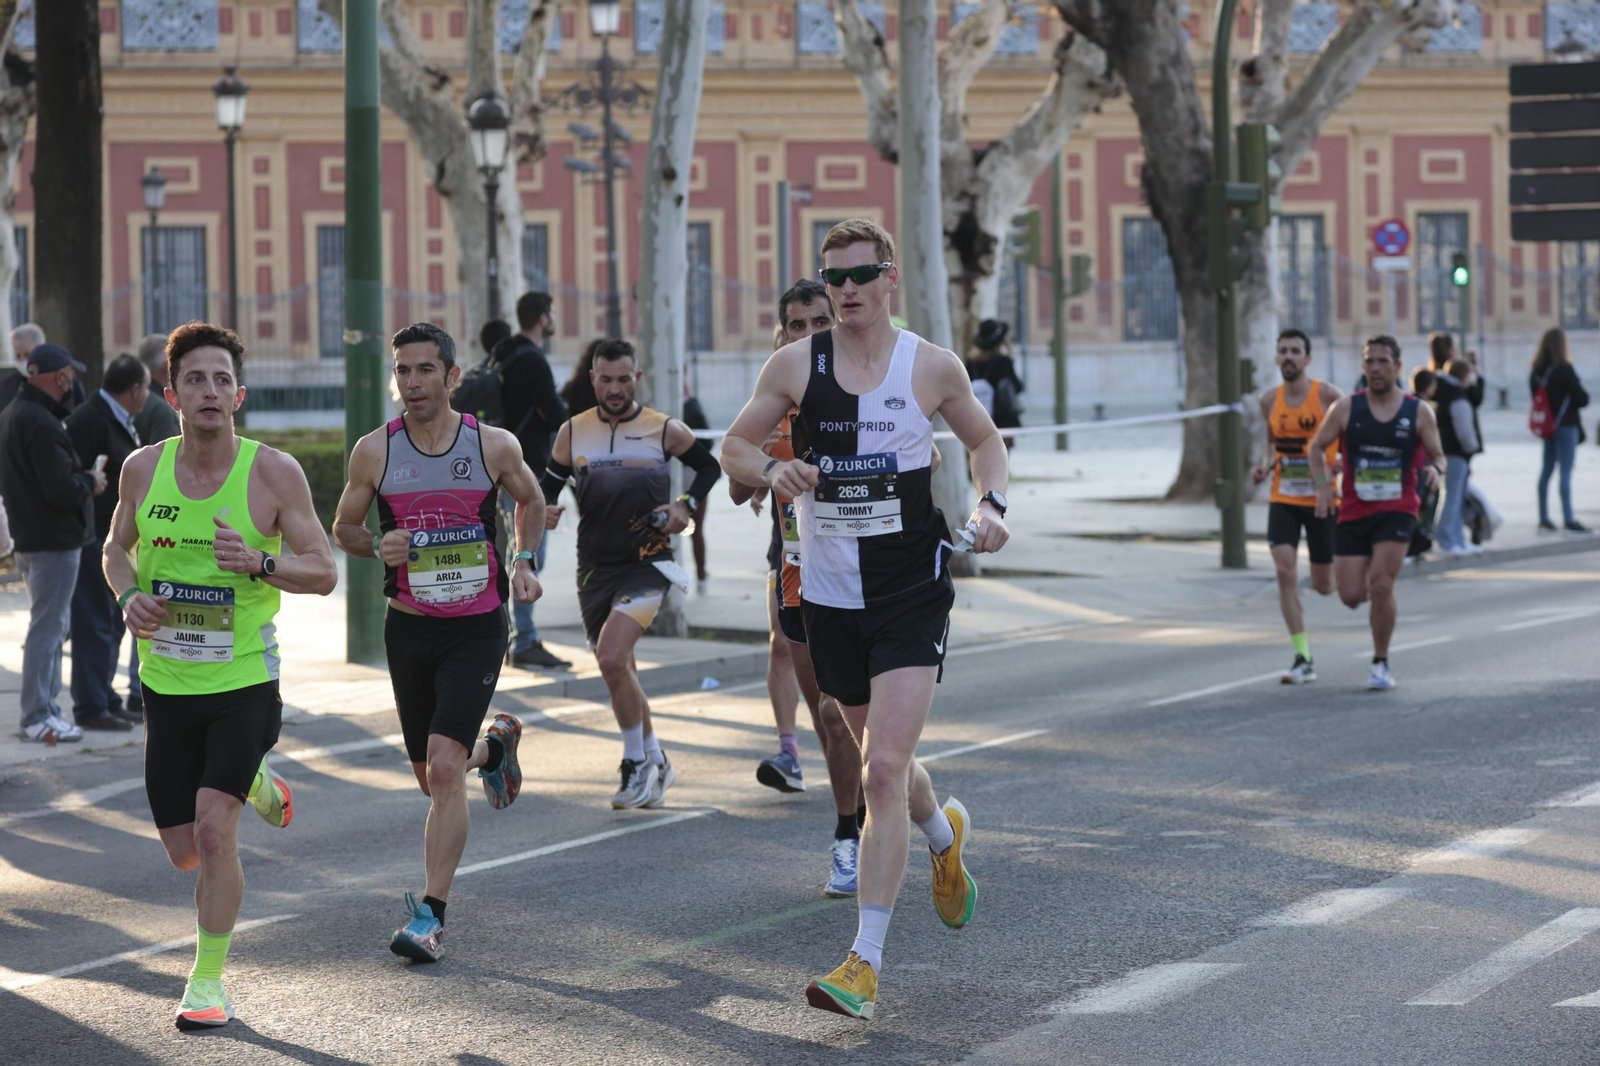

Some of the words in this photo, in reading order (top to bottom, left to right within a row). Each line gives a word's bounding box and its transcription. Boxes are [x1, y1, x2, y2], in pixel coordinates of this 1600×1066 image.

[818, 354, 826, 374] soar
[820, 422, 895, 432] PONTYPRIDD
[836, 457, 886, 471] ZURICH
[838, 485, 869, 498] 2626
[837, 505, 873, 516] TOMMY
[181, 538, 213, 546] MARATH
[432, 529, 476, 543] ZURICH
[434, 553, 461, 566] 1488
[436, 571, 462, 582] ARIZA
[176, 588, 224, 601] ZURICH
[176, 612, 204, 626] 1130
[174, 631, 206, 643] JAUME
